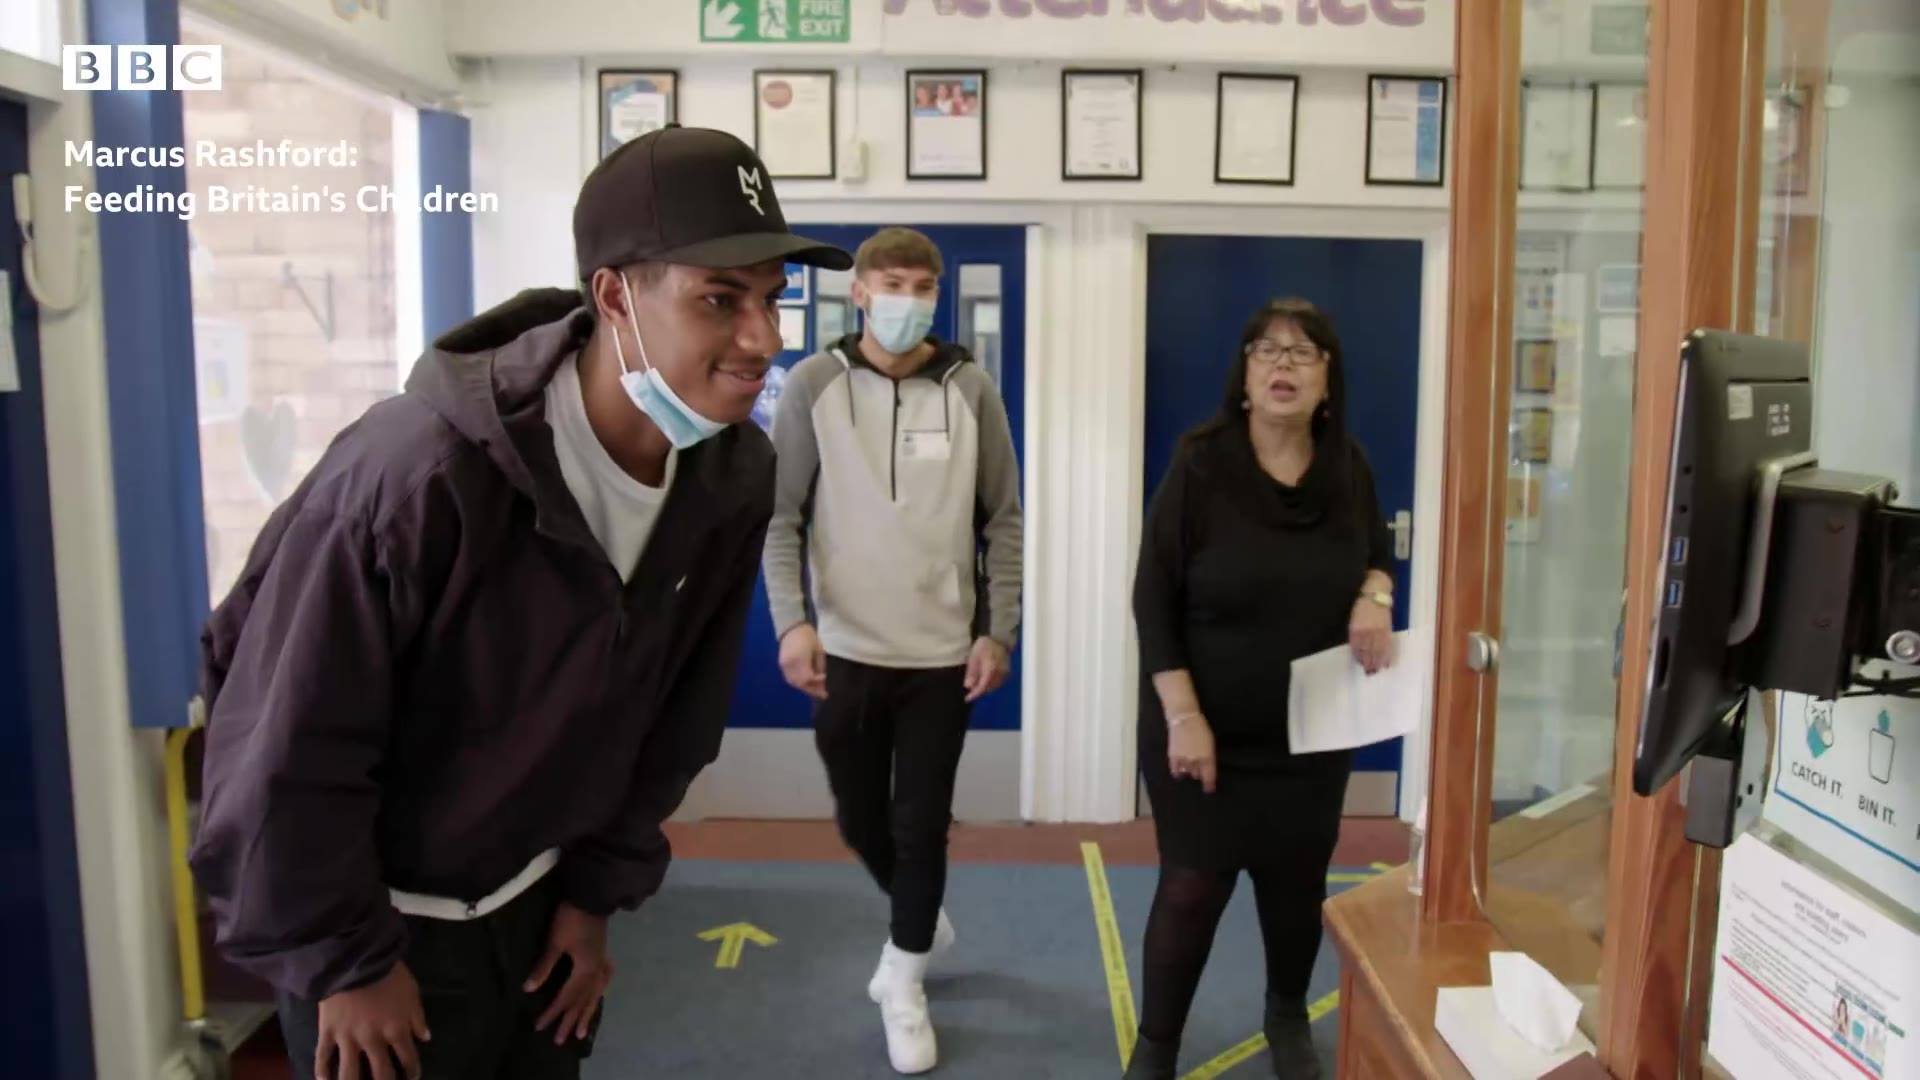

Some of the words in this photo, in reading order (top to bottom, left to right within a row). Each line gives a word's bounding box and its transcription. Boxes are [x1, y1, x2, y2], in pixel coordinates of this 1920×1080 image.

[800, 0, 842, 16] FIRE
[800, 20, 842, 36] EXIT
[1791, 761, 1827, 790] CATCH
[1858, 794, 1879, 818] BIN
